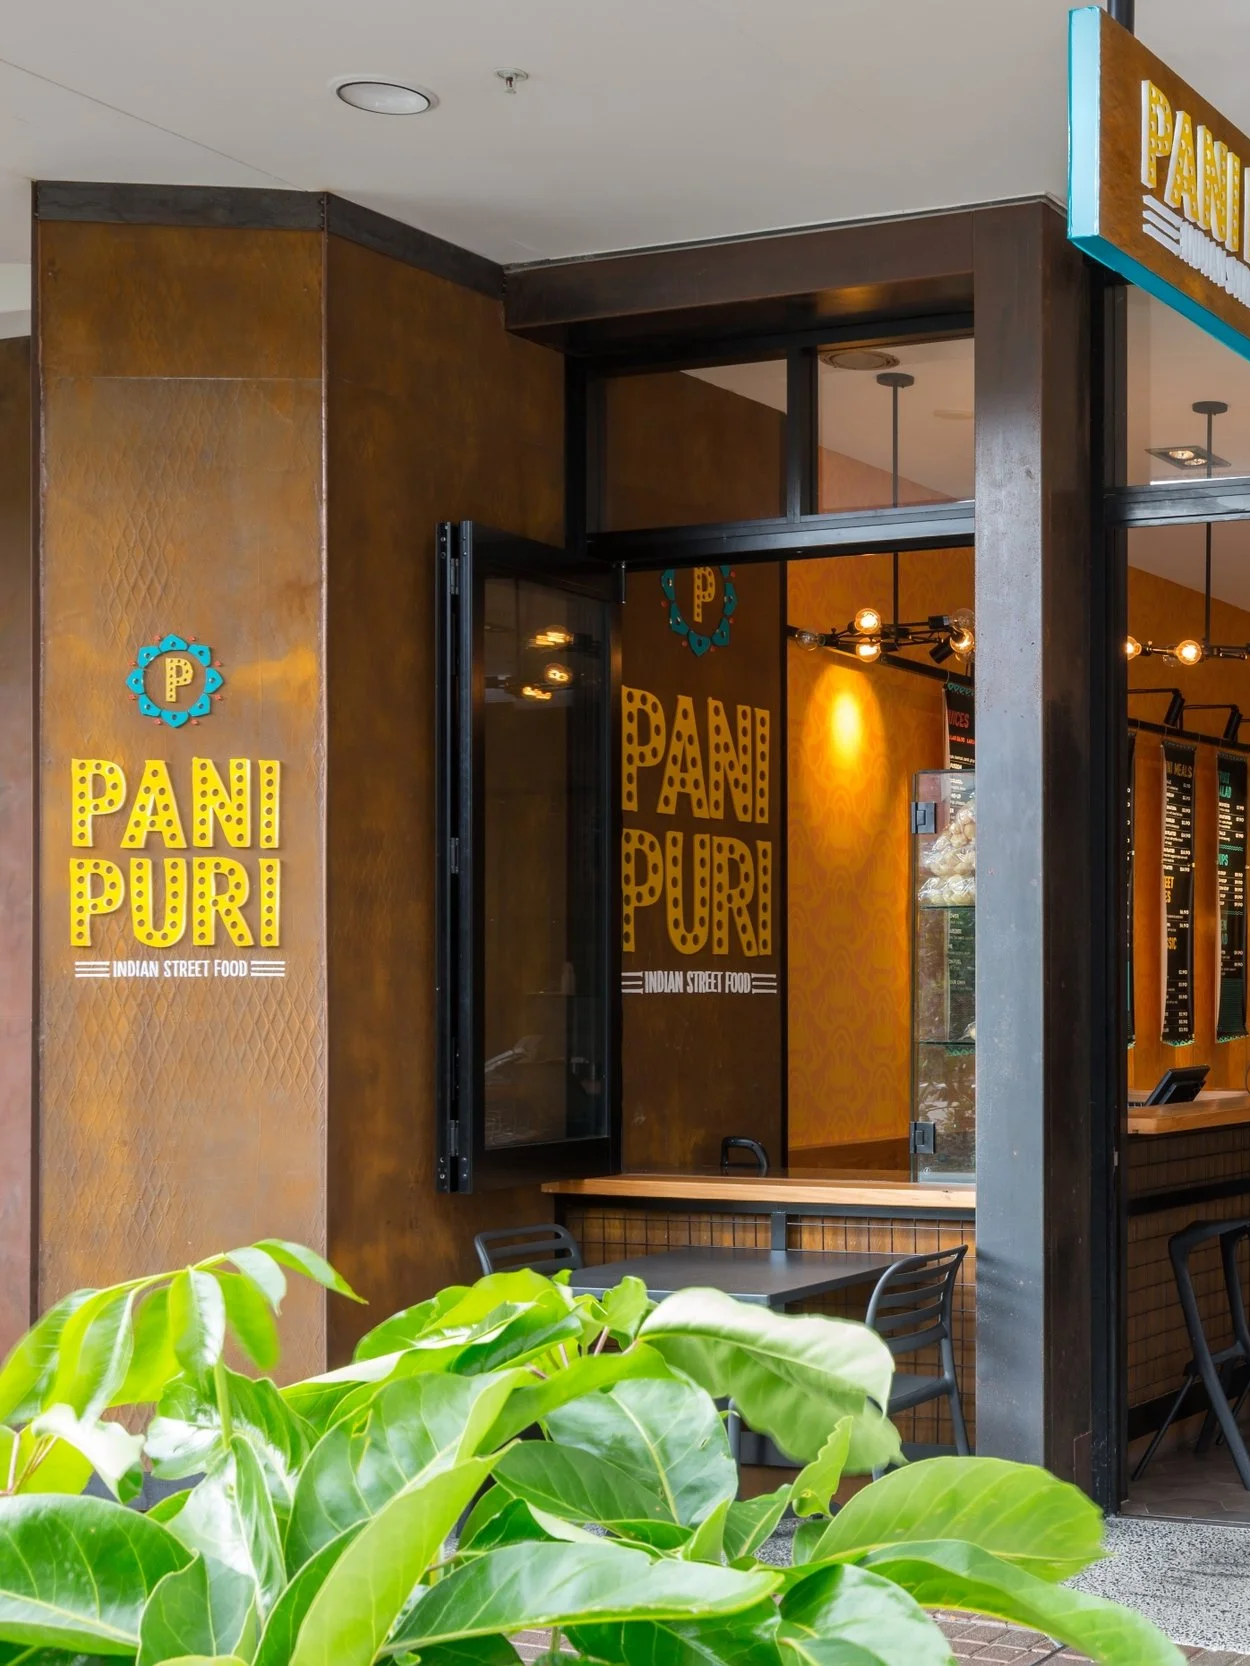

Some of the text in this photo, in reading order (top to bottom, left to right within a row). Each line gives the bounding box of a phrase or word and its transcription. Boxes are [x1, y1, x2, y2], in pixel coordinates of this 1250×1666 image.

[1141, 80, 1240, 252] PANI
[165, 657, 194, 702] P
[621, 685, 770, 823] PANI
[71, 757, 281, 849] PANI
[70, 857, 281, 948] PURI
[622, 828, 772, 957] PURI
[113, 959, 248, 977] INDIAN STREET FOOD
[644, 970, 750, 993] INDIAN STREET FOOD
